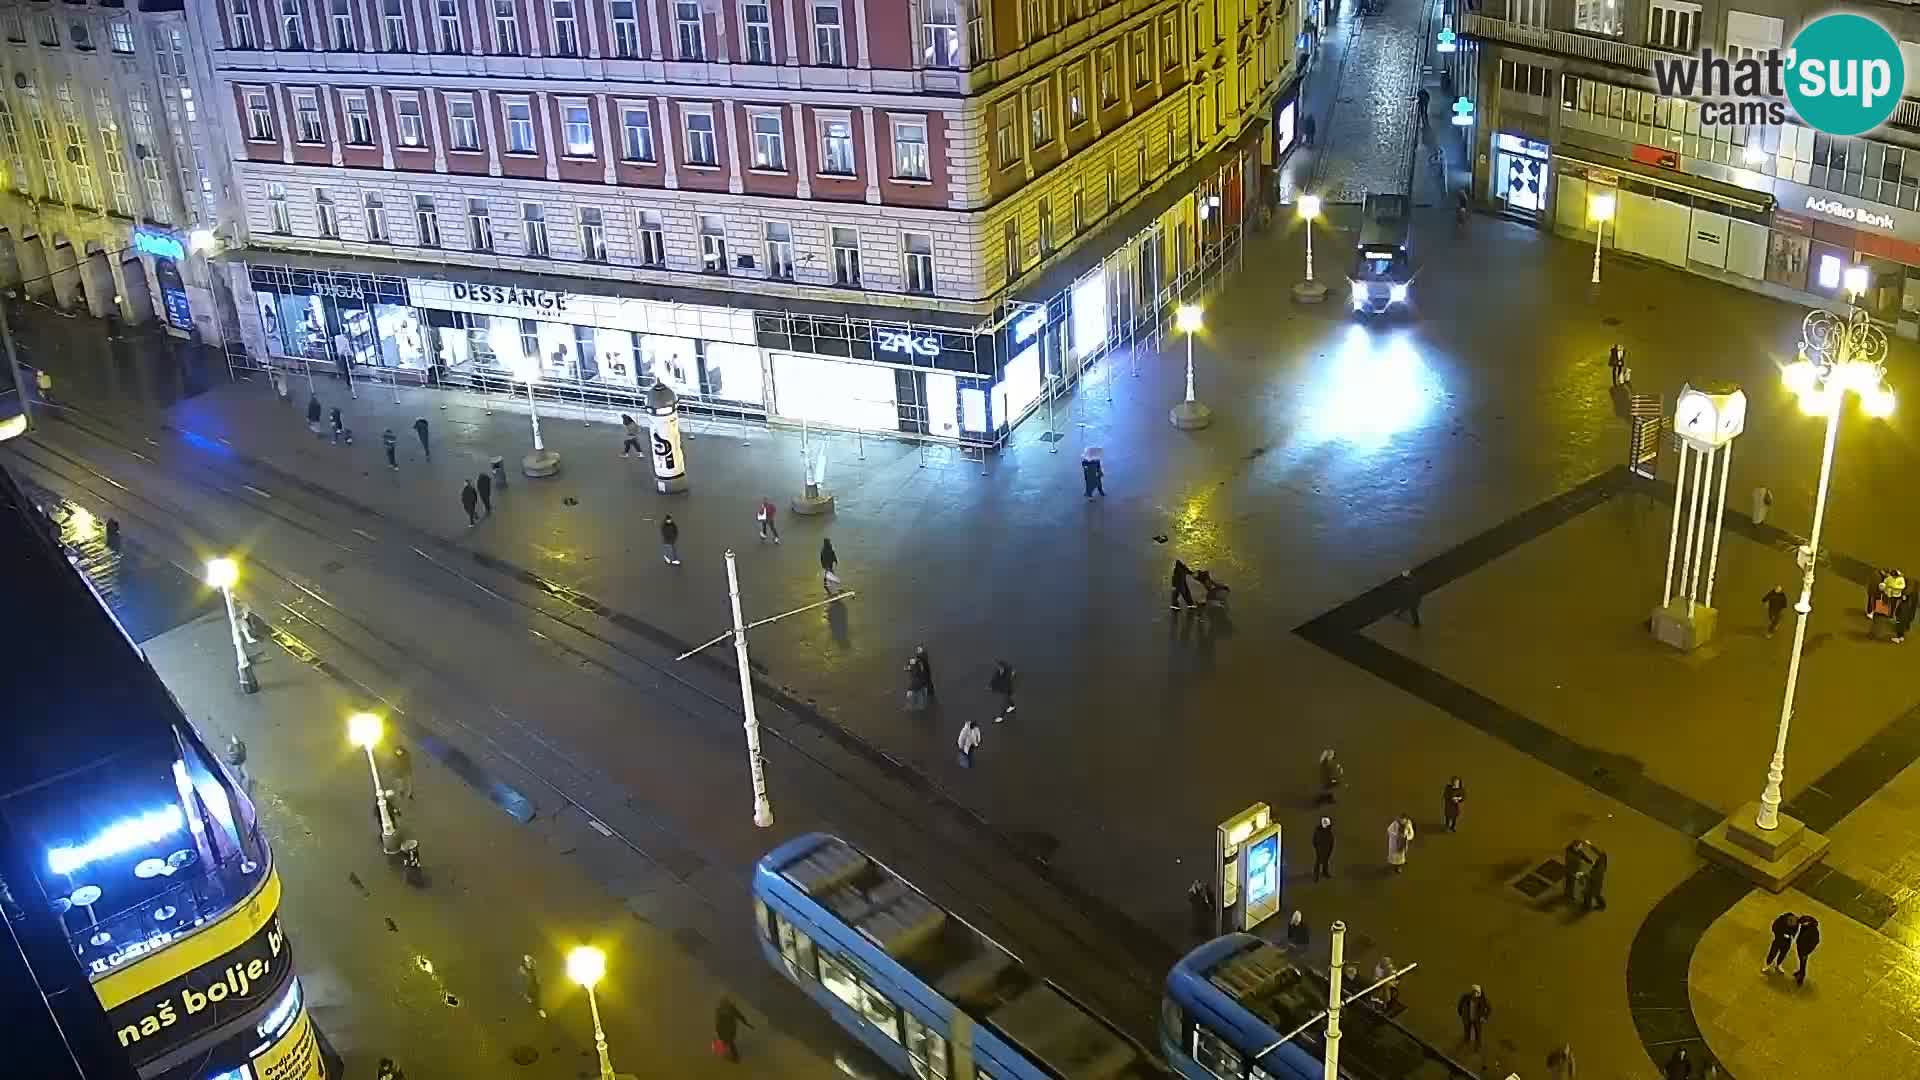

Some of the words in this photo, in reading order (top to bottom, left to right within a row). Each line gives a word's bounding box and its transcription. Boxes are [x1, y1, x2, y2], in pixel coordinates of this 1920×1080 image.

[1856, 208, 1895, 232] Bank
[453, 283, 569, 311] DESSANGE
[877, 331, 940, 356] ZAKS
[117, 999, 177, 1047] naš
[182, 957, 270, 1015] bolje,
